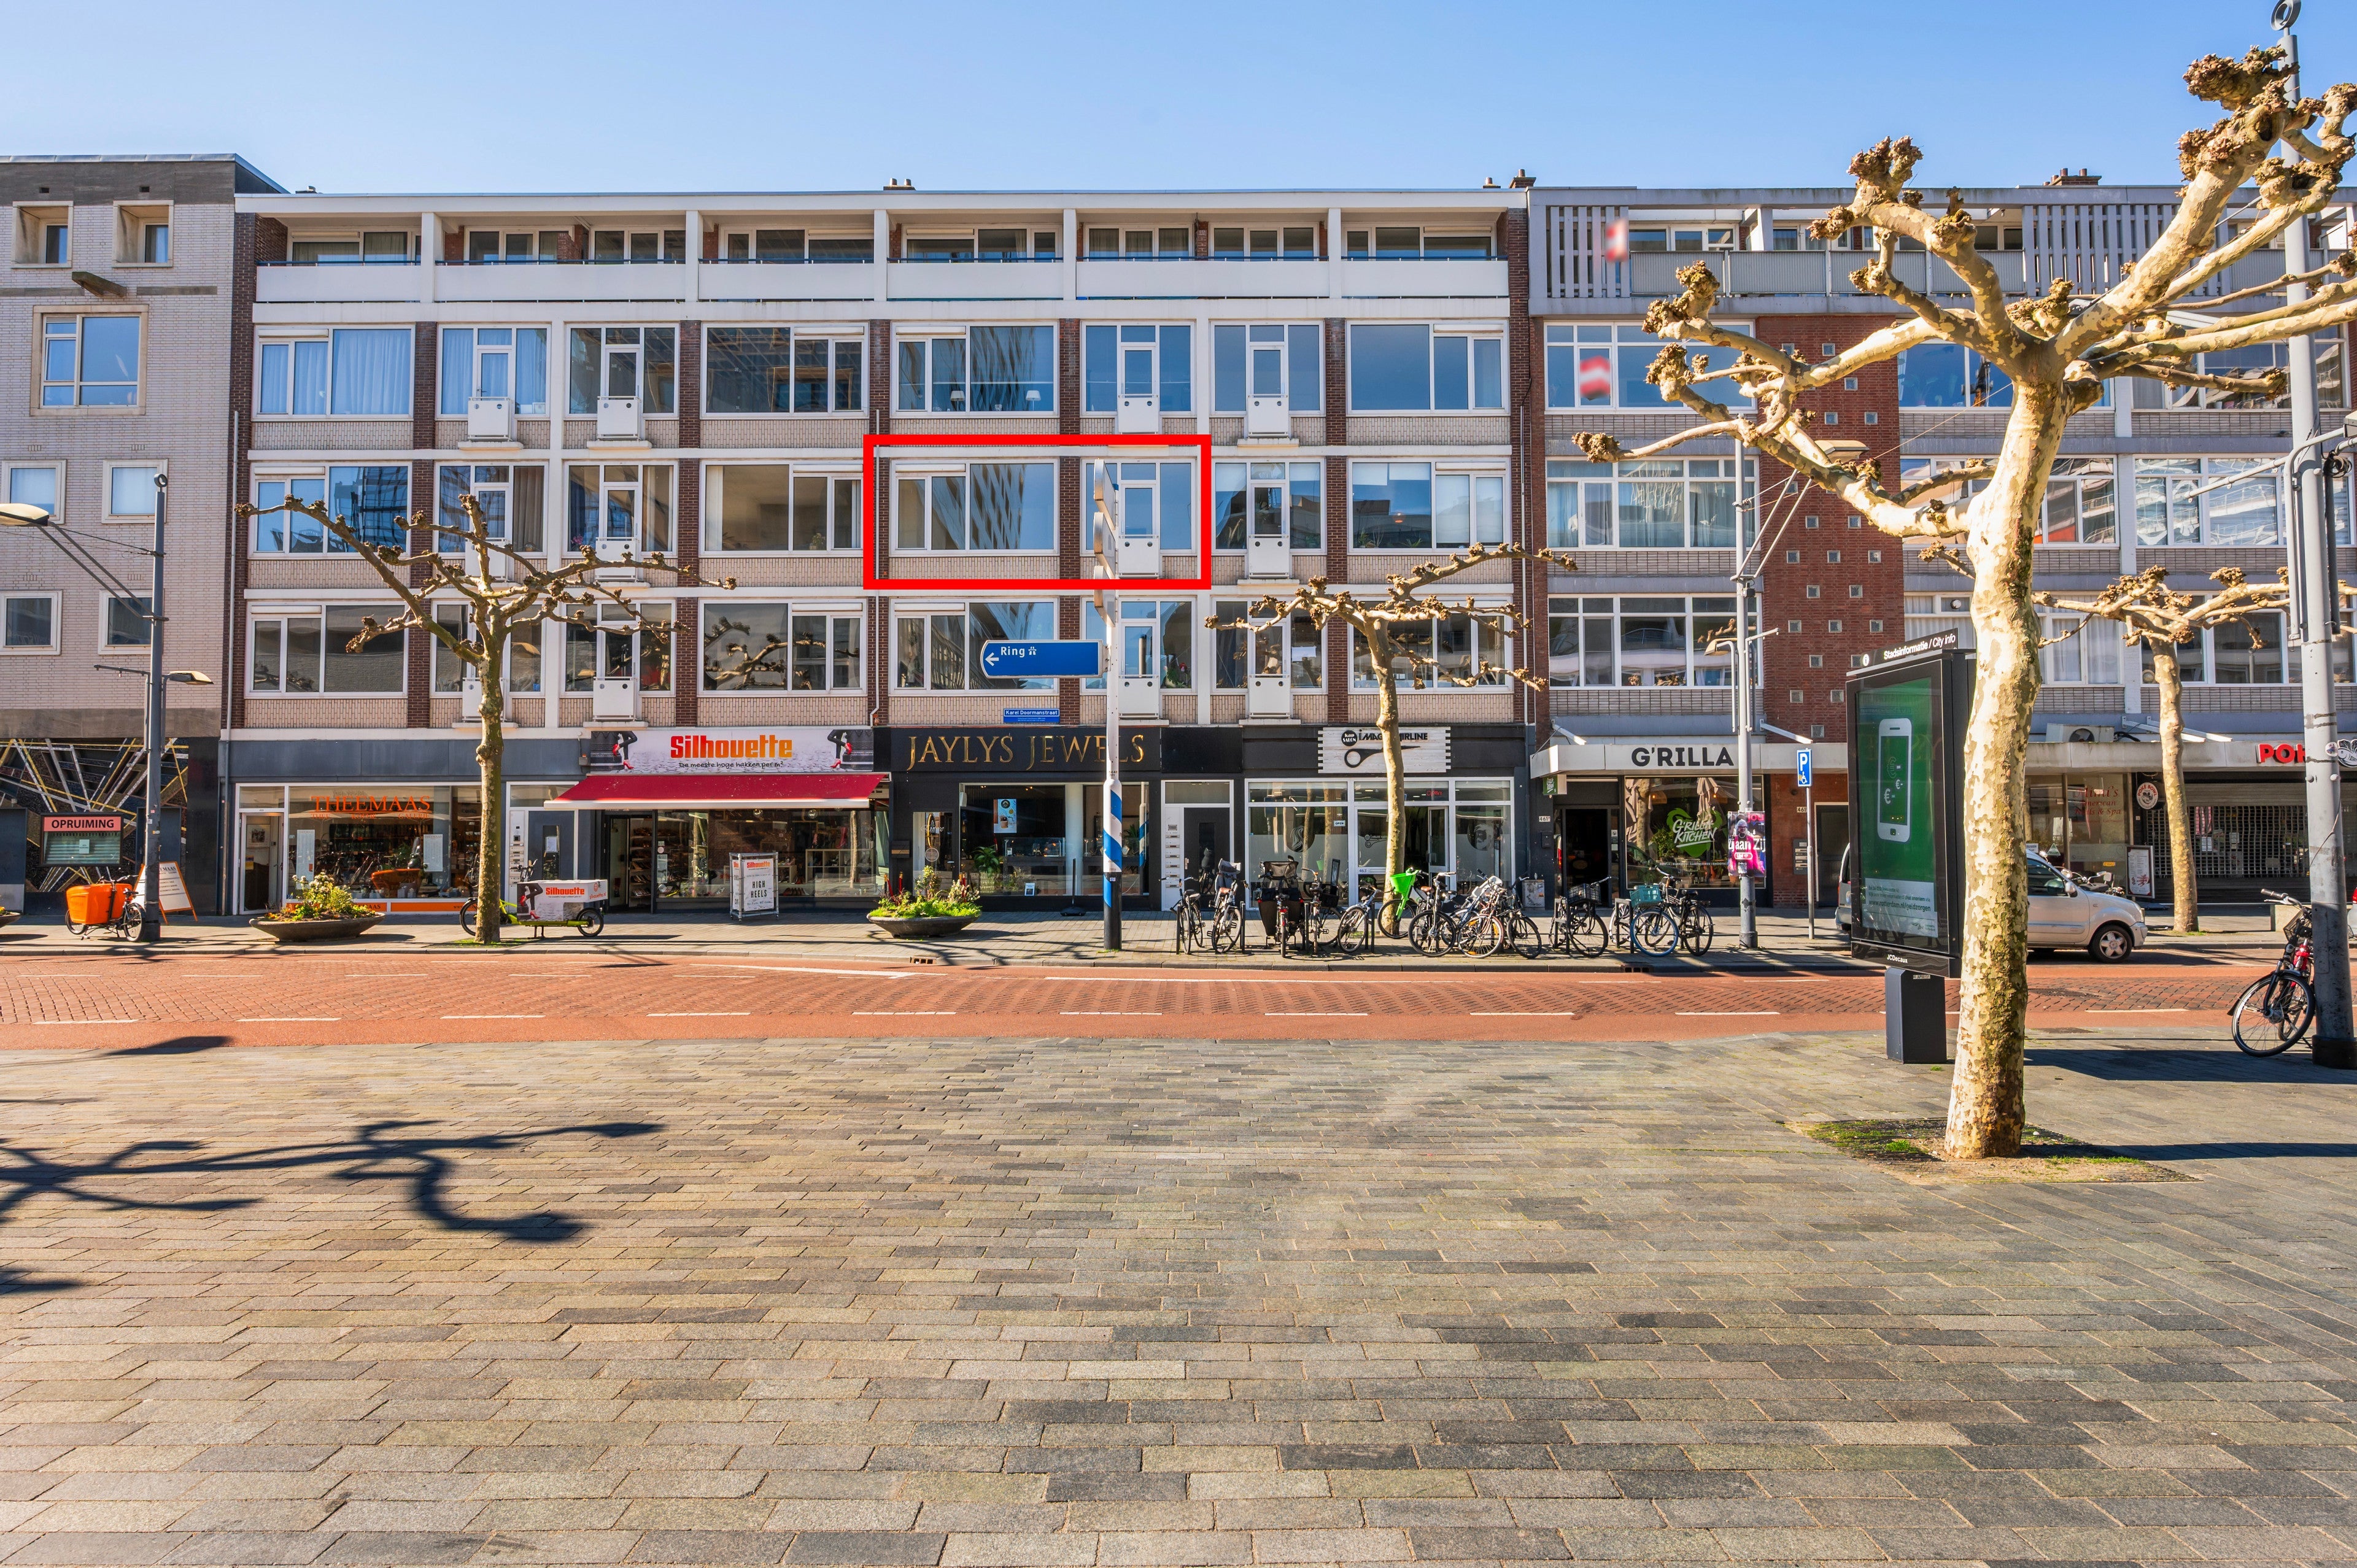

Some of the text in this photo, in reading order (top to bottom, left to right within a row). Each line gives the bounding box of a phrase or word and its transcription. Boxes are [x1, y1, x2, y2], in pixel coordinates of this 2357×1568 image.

[1000, 646, 1025, 658] Ring
[1884, 641, 1928, 660] Stadsinformatie
[1933, 637, 1944, 648] City
[1945, 633, 1956, 644] info
[670, 735, 792, 759] Silhouette
[907, 735, 1013, 771] JAYLYS
[1631, 746, 1735, 767] G'RILLA
[311, 795, 430, 811] THEEMAAS
[52, 819, 114, 828] OPRUIMING
[1674, 827, 1717, 844] KITCHEN
[1753, 838, 1766, 853] Zij
[546, 887, 585, 895] Silhouette
[752, 880, 765, 889] HIGH
[1886, 954, 1908, 964] JCDecaux
